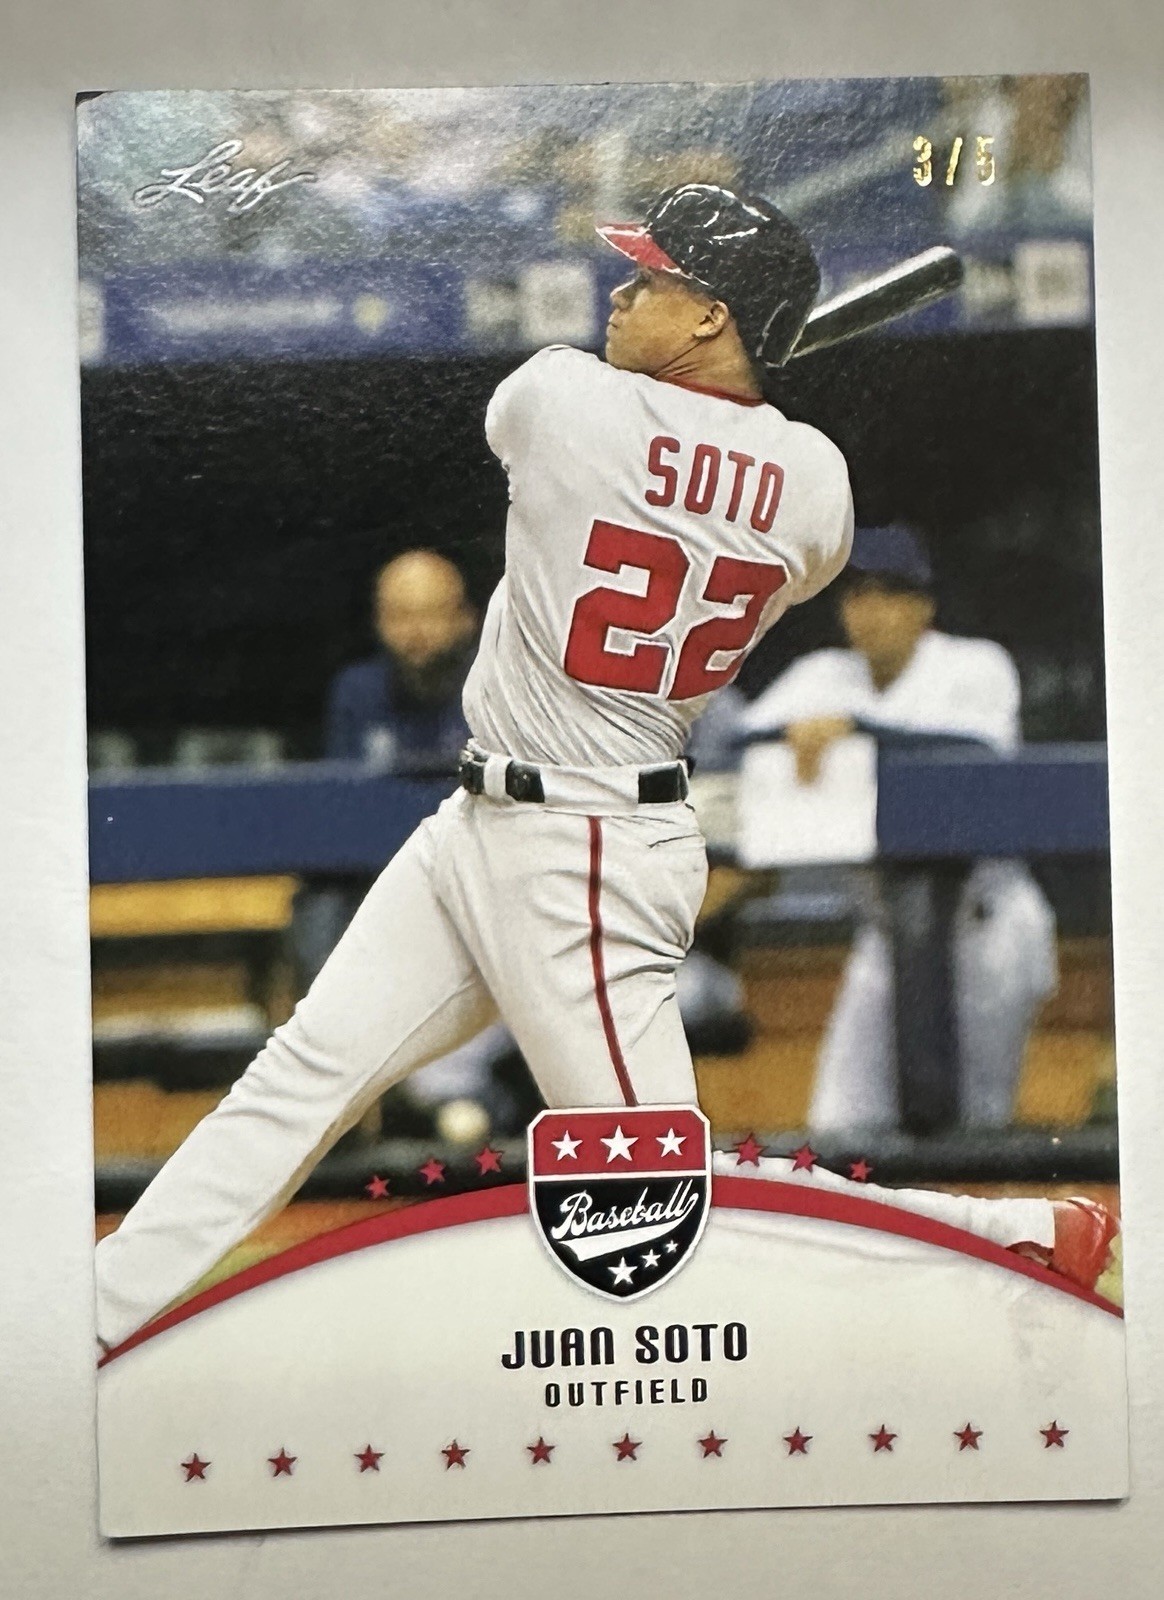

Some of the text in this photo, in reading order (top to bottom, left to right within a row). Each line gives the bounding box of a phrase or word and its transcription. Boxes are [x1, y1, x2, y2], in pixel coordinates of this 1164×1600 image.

[133, 139, 317, 212] Leaf
[645, 435, 785, 533] SOTO
[563, 519, 789, 701] 22
[551, 1178, 699, 1240] Baseball
[501, 1322, 748, 1369] JUAN SOTO
[545, 1377, 708, 1407] OUTFIELD
